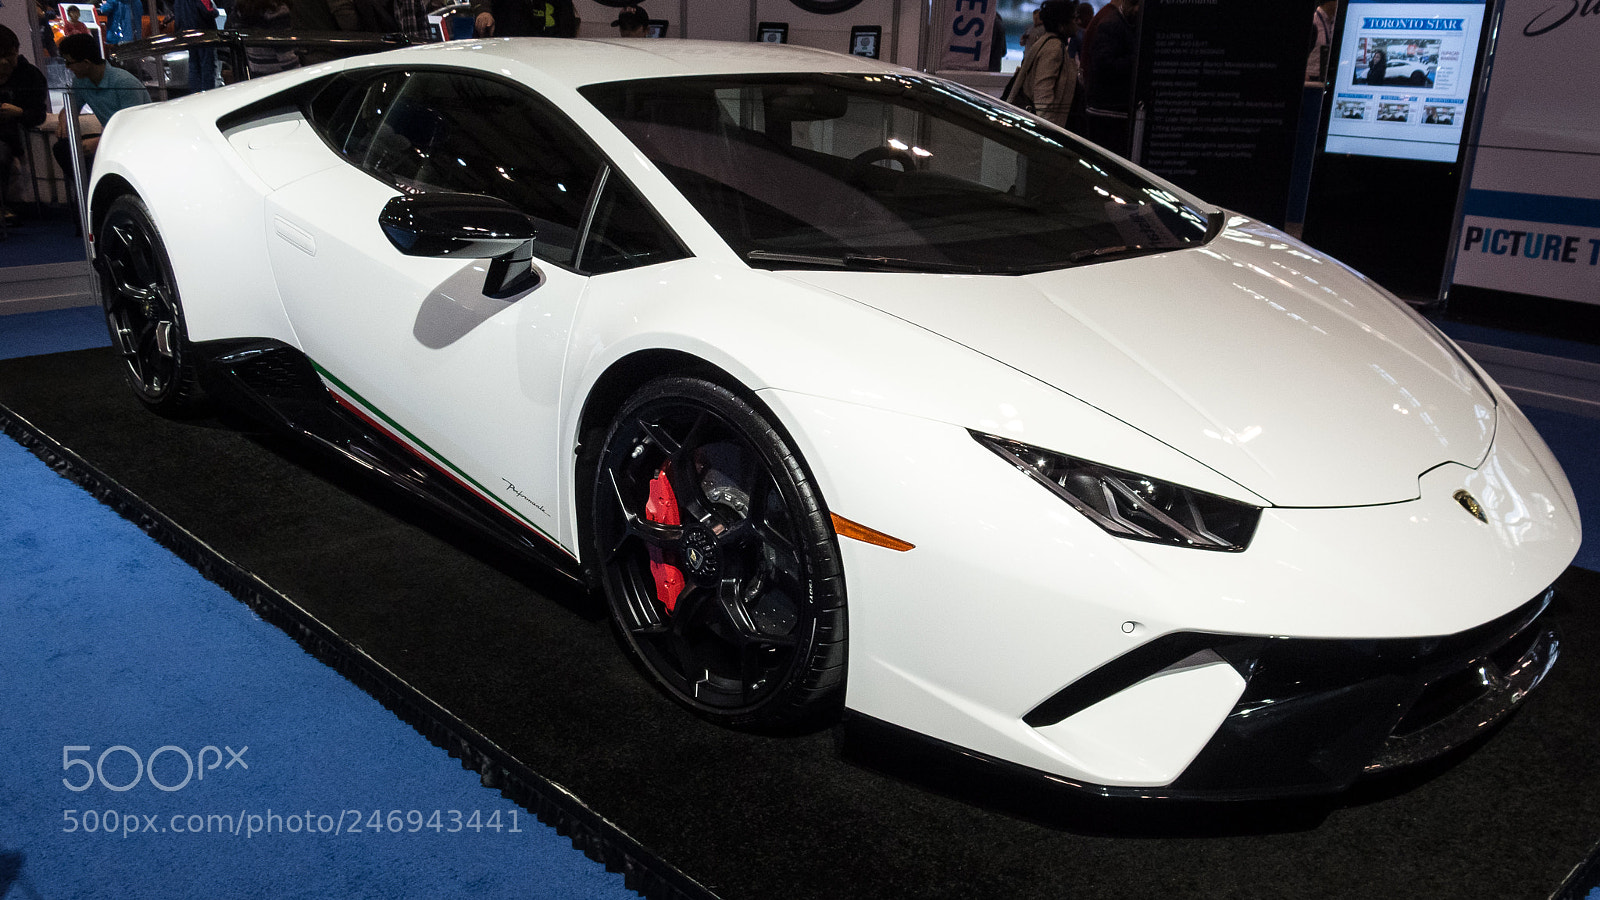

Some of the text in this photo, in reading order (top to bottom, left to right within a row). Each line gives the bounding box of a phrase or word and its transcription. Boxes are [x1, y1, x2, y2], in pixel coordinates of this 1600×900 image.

[1368, 17, 1457, 29] TORONTO STAR
[1464, 226, 1580, 263] PICTURE
